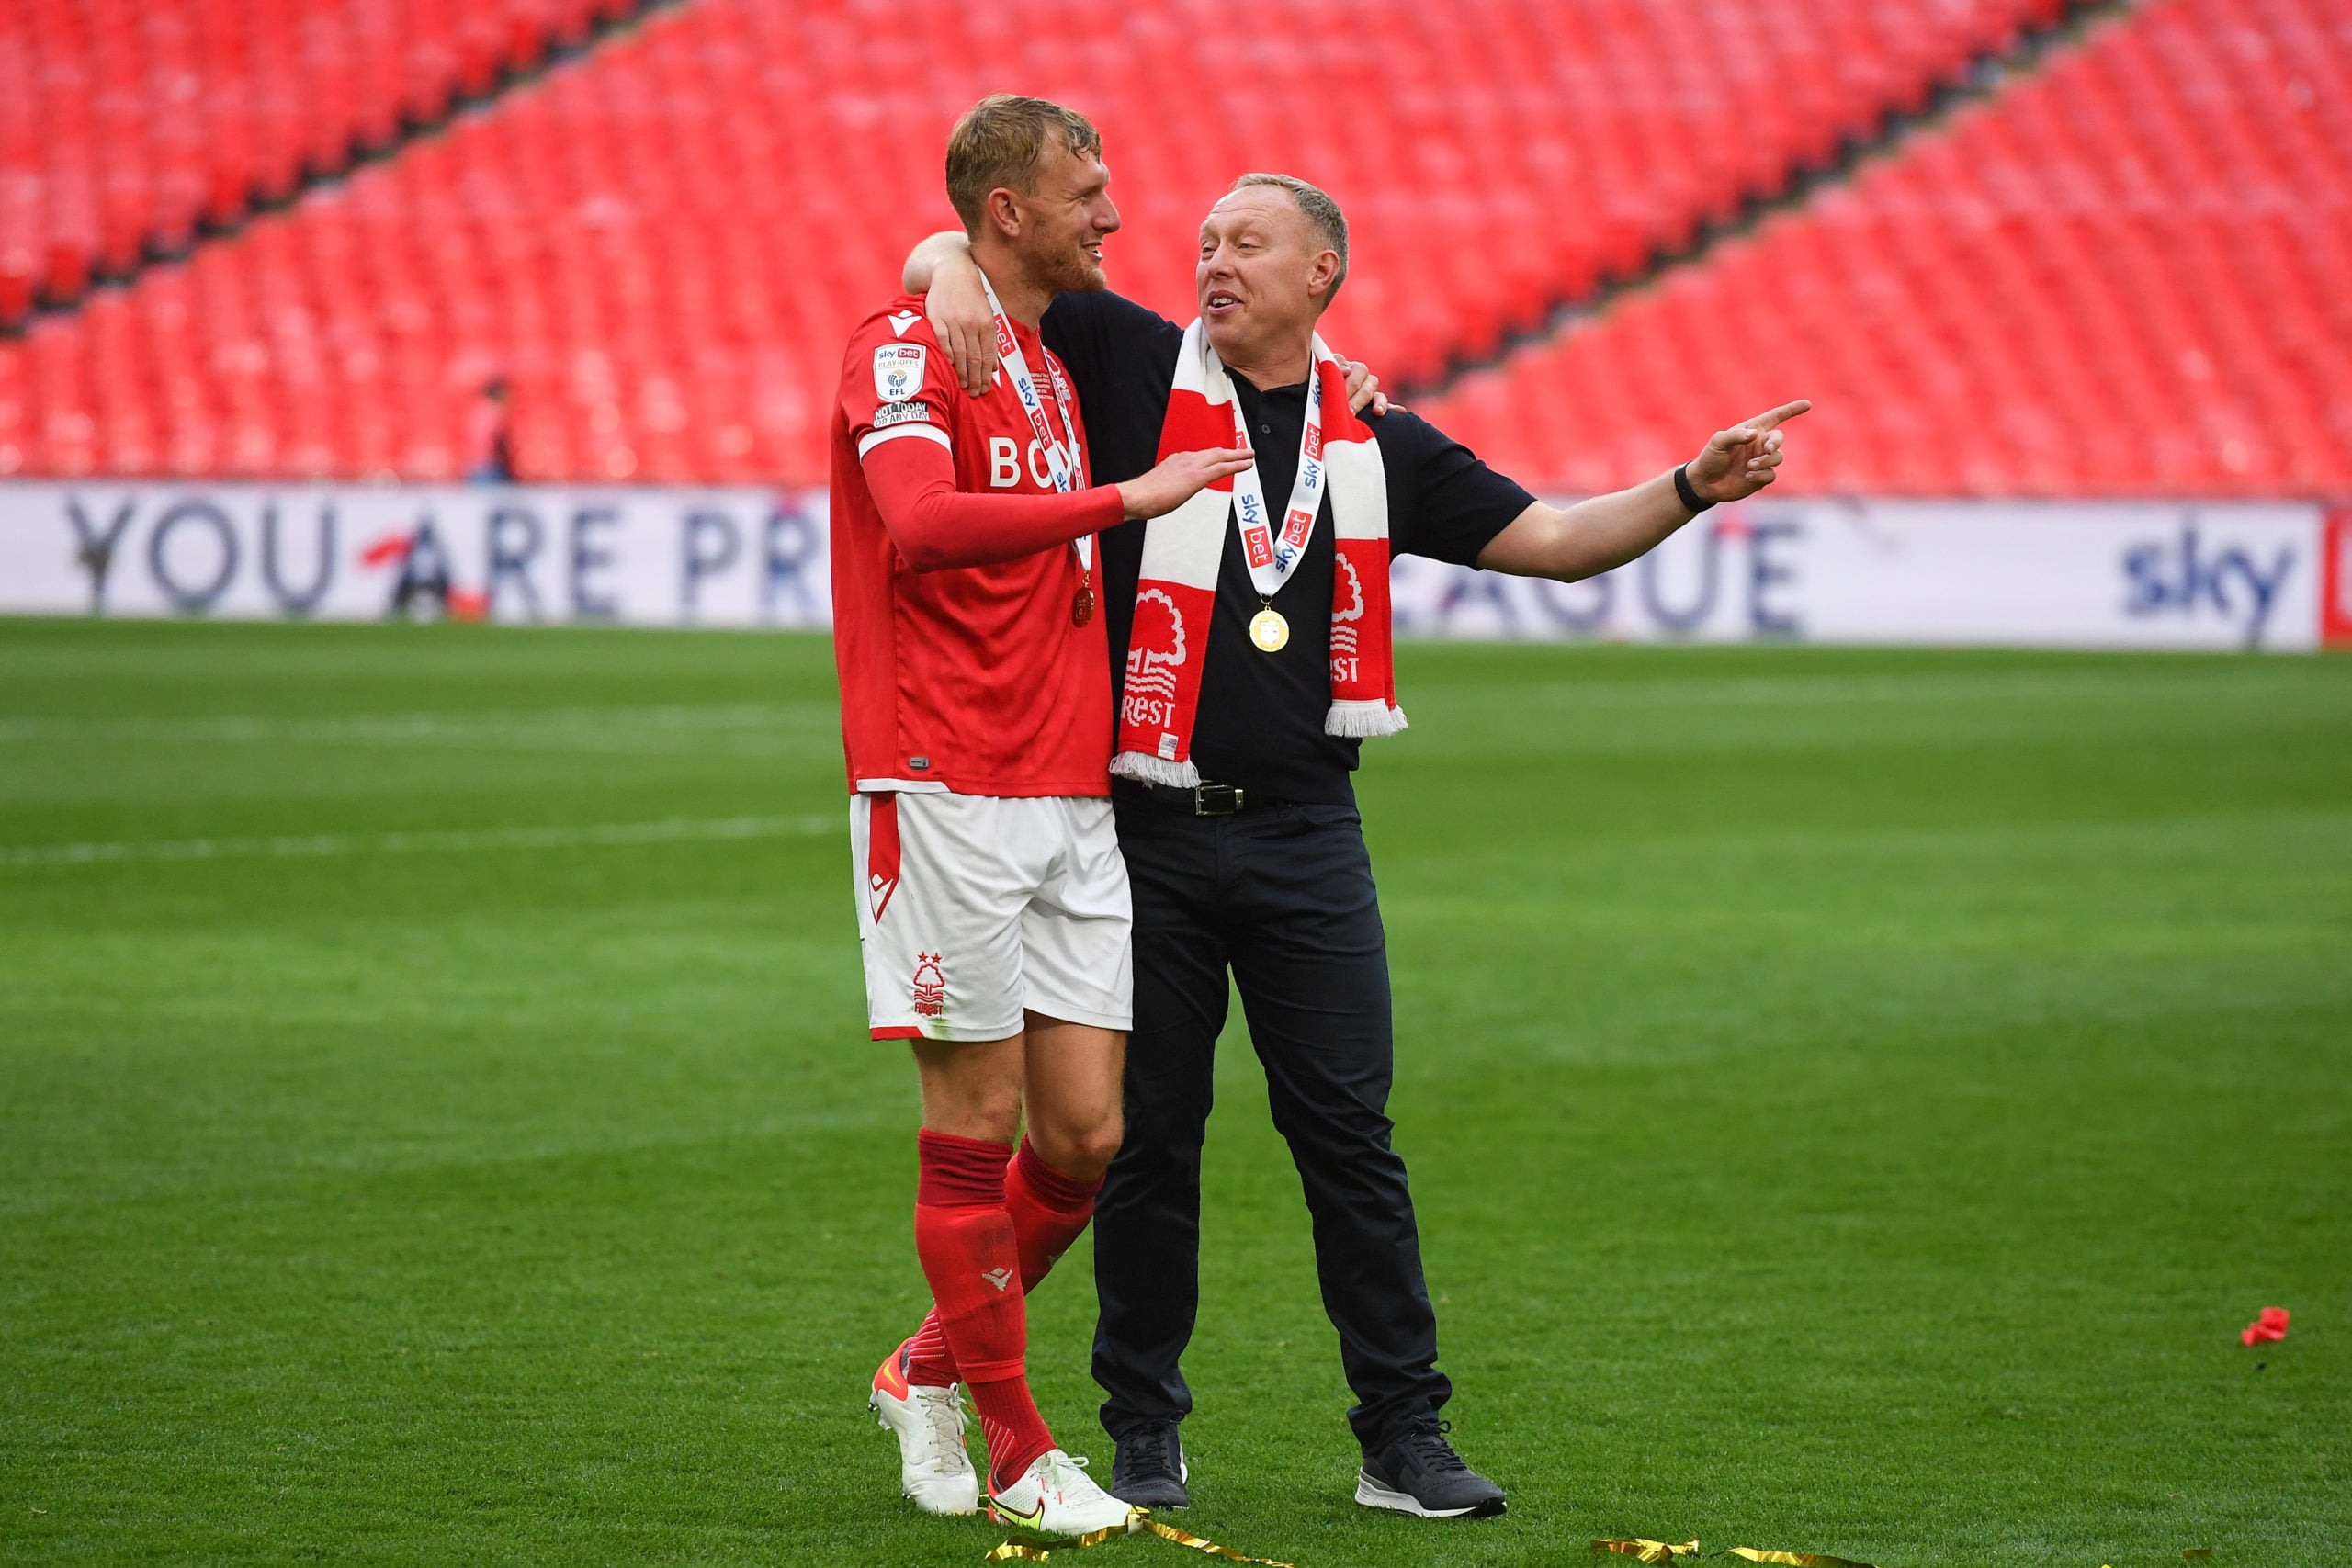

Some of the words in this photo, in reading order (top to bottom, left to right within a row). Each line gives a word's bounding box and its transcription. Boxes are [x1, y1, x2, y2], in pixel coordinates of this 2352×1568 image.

[995, 319, 1012, 354] bet
[878, 350, 896, 359] sky
[899, 348, 918, 358] bet
[878, 359, 919, 367] PLAY-OFFS
[875, 403, 892, 420] NOT
[895, 401, 926, 412] TODAY
[876, 417, 888, 426] OR
[889, 412, 908, 423] ANY
[911, 412, 928, 421] DAY
[1018, 377, 1035, 407] sky
[1034, 413, 1050, 446] bet
[1308, 428, 1320, 457] bet
[989, 437, 1080, 489] BOX
[1304, 459, 1321, 489] sky
[1241, 494, 1260, 524] sky
[1250, 530, 1268, 564] bet
[1275, 544, 1297, 573] sky
[1288, 514, 1306, 545] bet
[66, 499, 336, 615] YOU
[384, 506, 623, 623] ARE
[2122, 519, 2297, 650] sky
